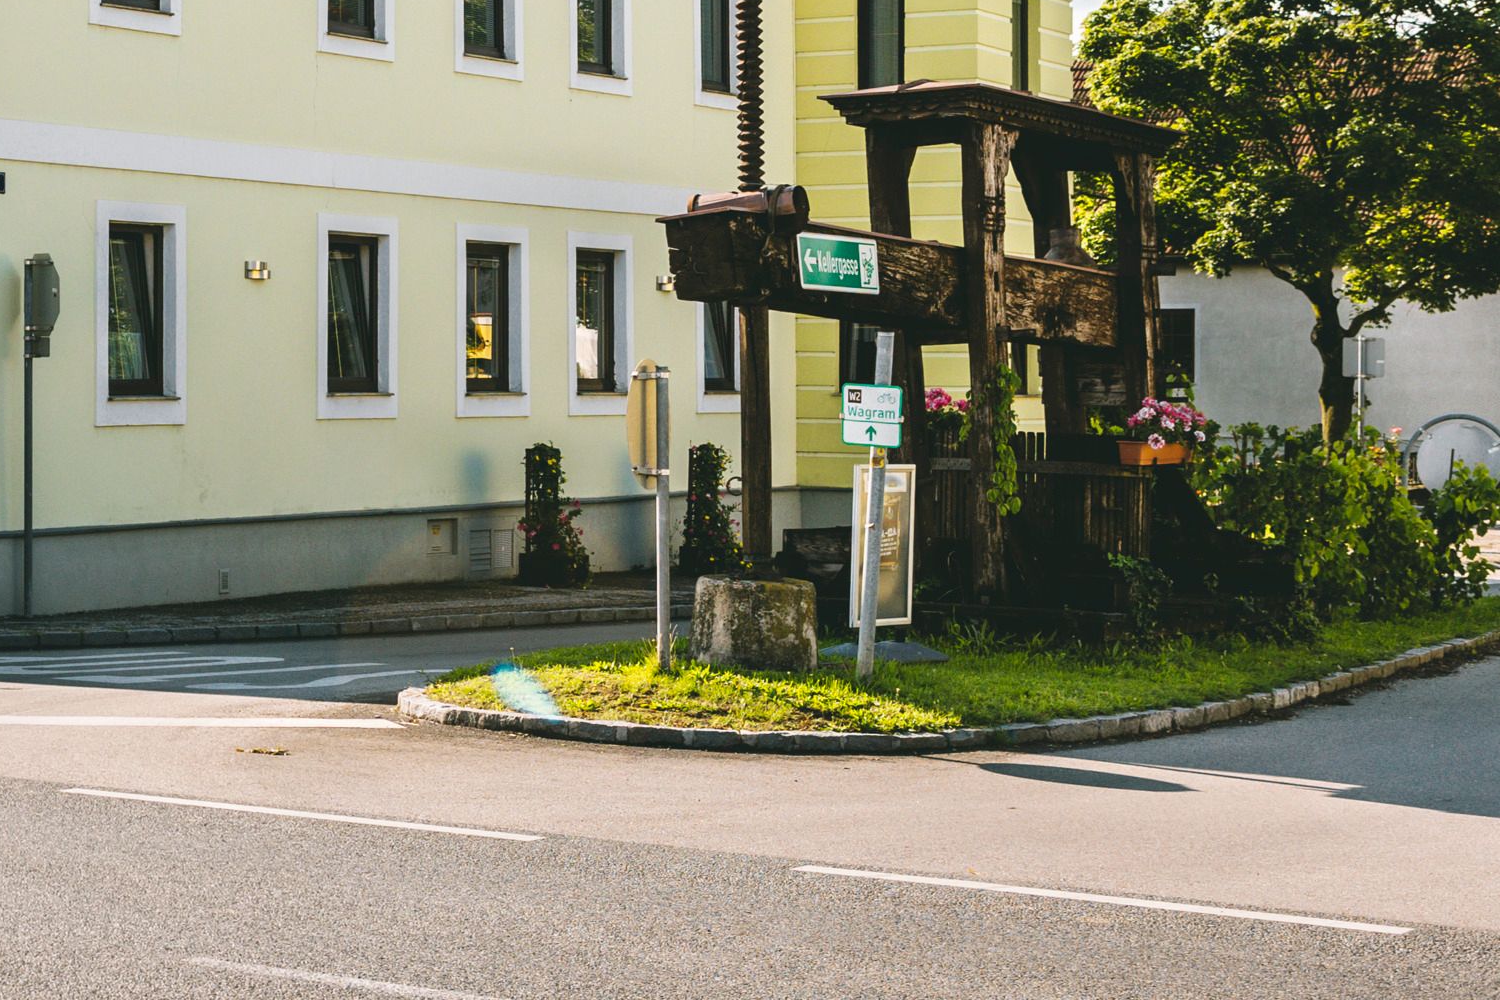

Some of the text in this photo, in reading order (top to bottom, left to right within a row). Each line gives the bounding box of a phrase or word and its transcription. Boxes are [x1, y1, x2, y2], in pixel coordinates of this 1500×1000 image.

[817, 249, 859, 280] Kellergasse
[848, 391, 861, 402] W2
[847, 406, 896, 420] Wagram
